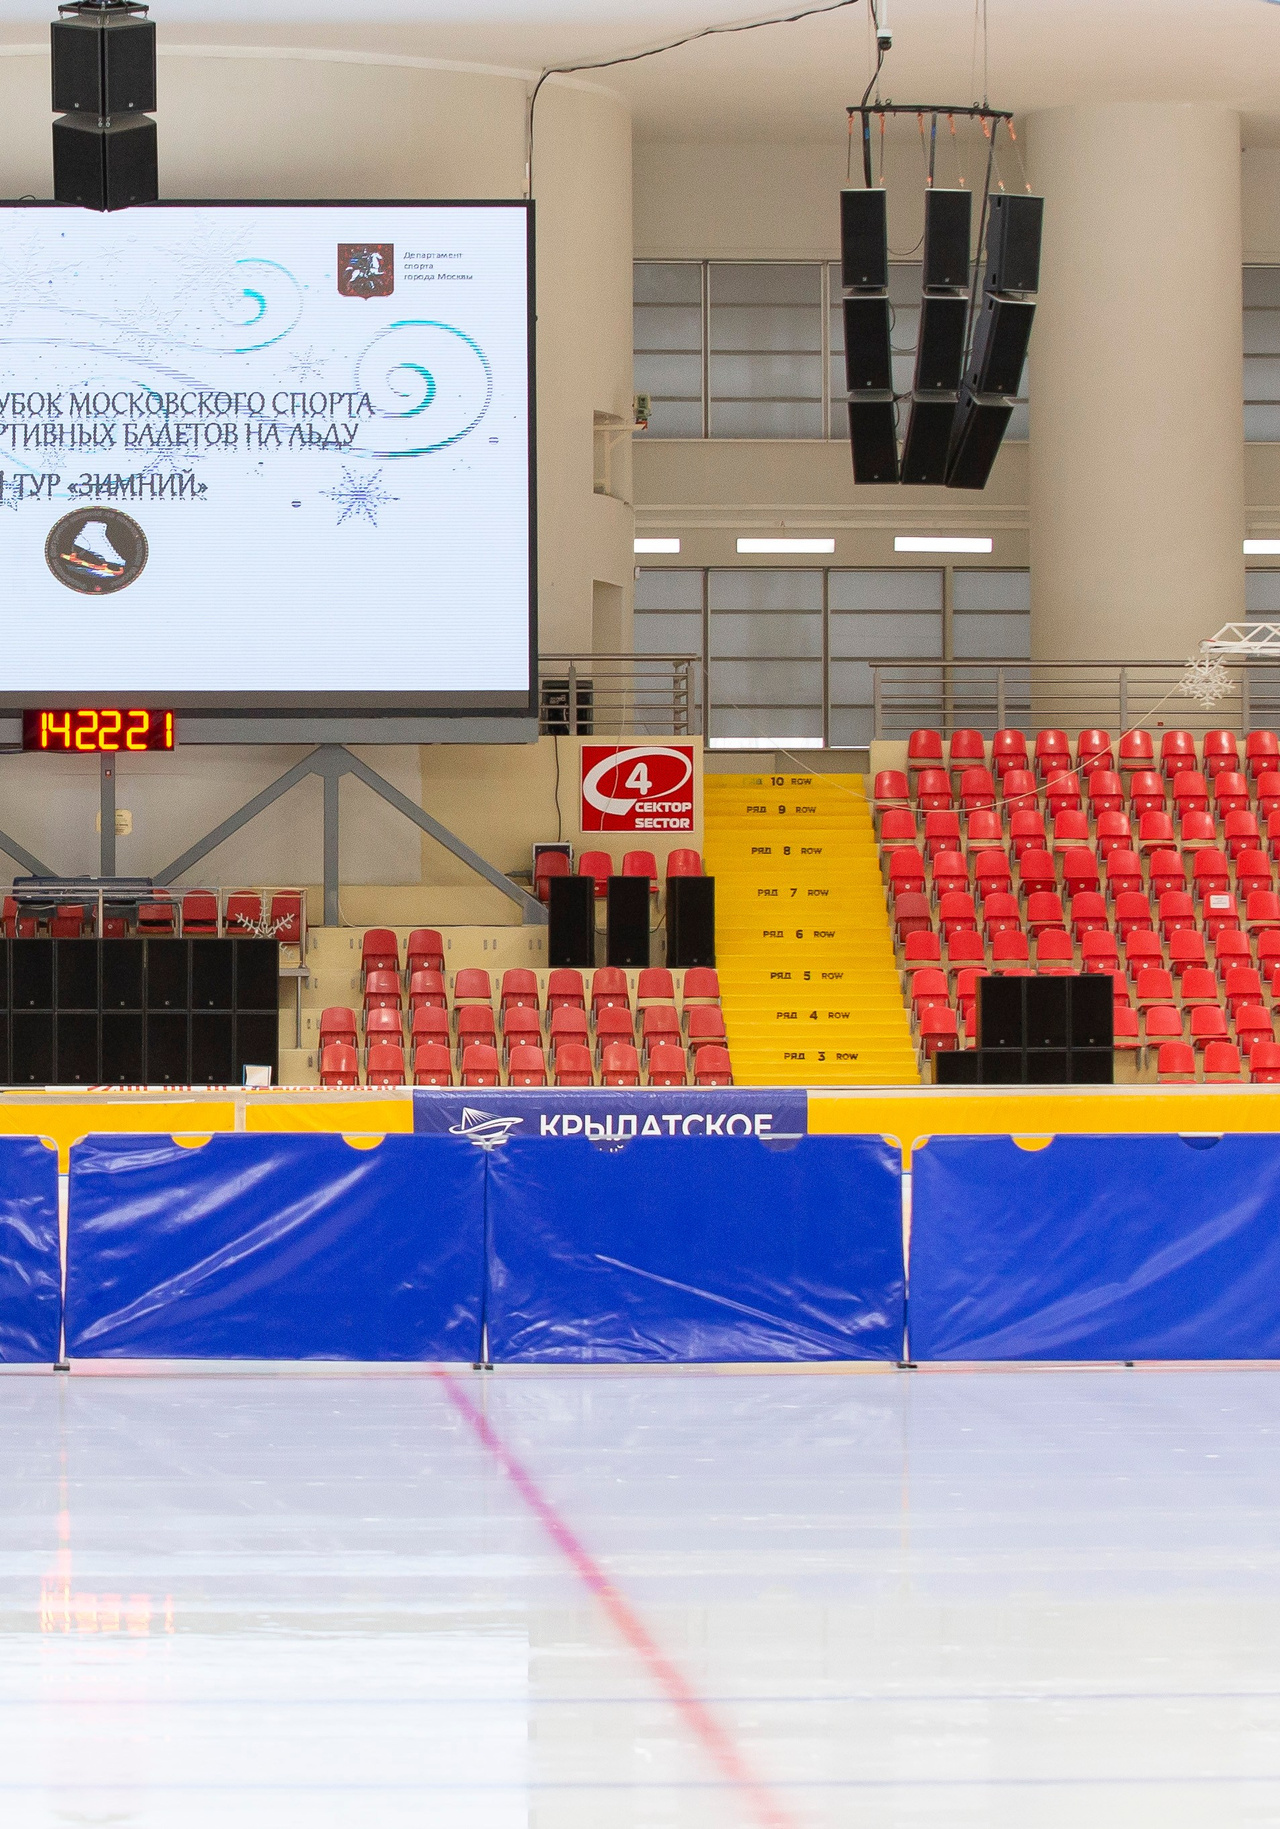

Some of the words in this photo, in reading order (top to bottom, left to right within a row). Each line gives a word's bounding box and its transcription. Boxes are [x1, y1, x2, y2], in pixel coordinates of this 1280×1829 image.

[403, 251, 463, 259] Департамент
[70, 392, 265, 417] МОСКОВСКОГО
[272, 392, 375, 417] СПОРТА
[124, 423, 238, 449] БАЛЕТОВ
[245, 423, 279, 449] НА
[289, 423, 359, 449] ЛЬДУ
[14, 473, 60, 499] ТУР
[68, 468, 208, 499] «ЗИМНИЙ»
[625, 762, 653, 796] 4
[770, 777, 784, 786] 10
[634, 802, 692, 813] СЕКТОР
[778, 804, 786, 814] 9
[634, 818, 690, 829] SECTOR
[783, 846, 791, 855] 8
[757, 889, 778, 897] РЯД
[790, 888, 798, 897] 7
[807, 889, 829, 897] ROW
[763, 930, 784, 938] РЯД
[795, 929, 803, 939] 6
[813, 930, 836, 938] ROW
[770, 972, 792, 980] РЯД
[803, 971, 811, 981] 5
[821, 972, 844, 980] ROW
[776, 1011, 798, 1019] РЯД
[809, 1010, 818, 1020] 4
[783, 1052, 805, 1060] РЯД
[818, 1051, 826, 1061] 3
[540, 1113, 773, 1140] КРЫЛАТСКОЕ
